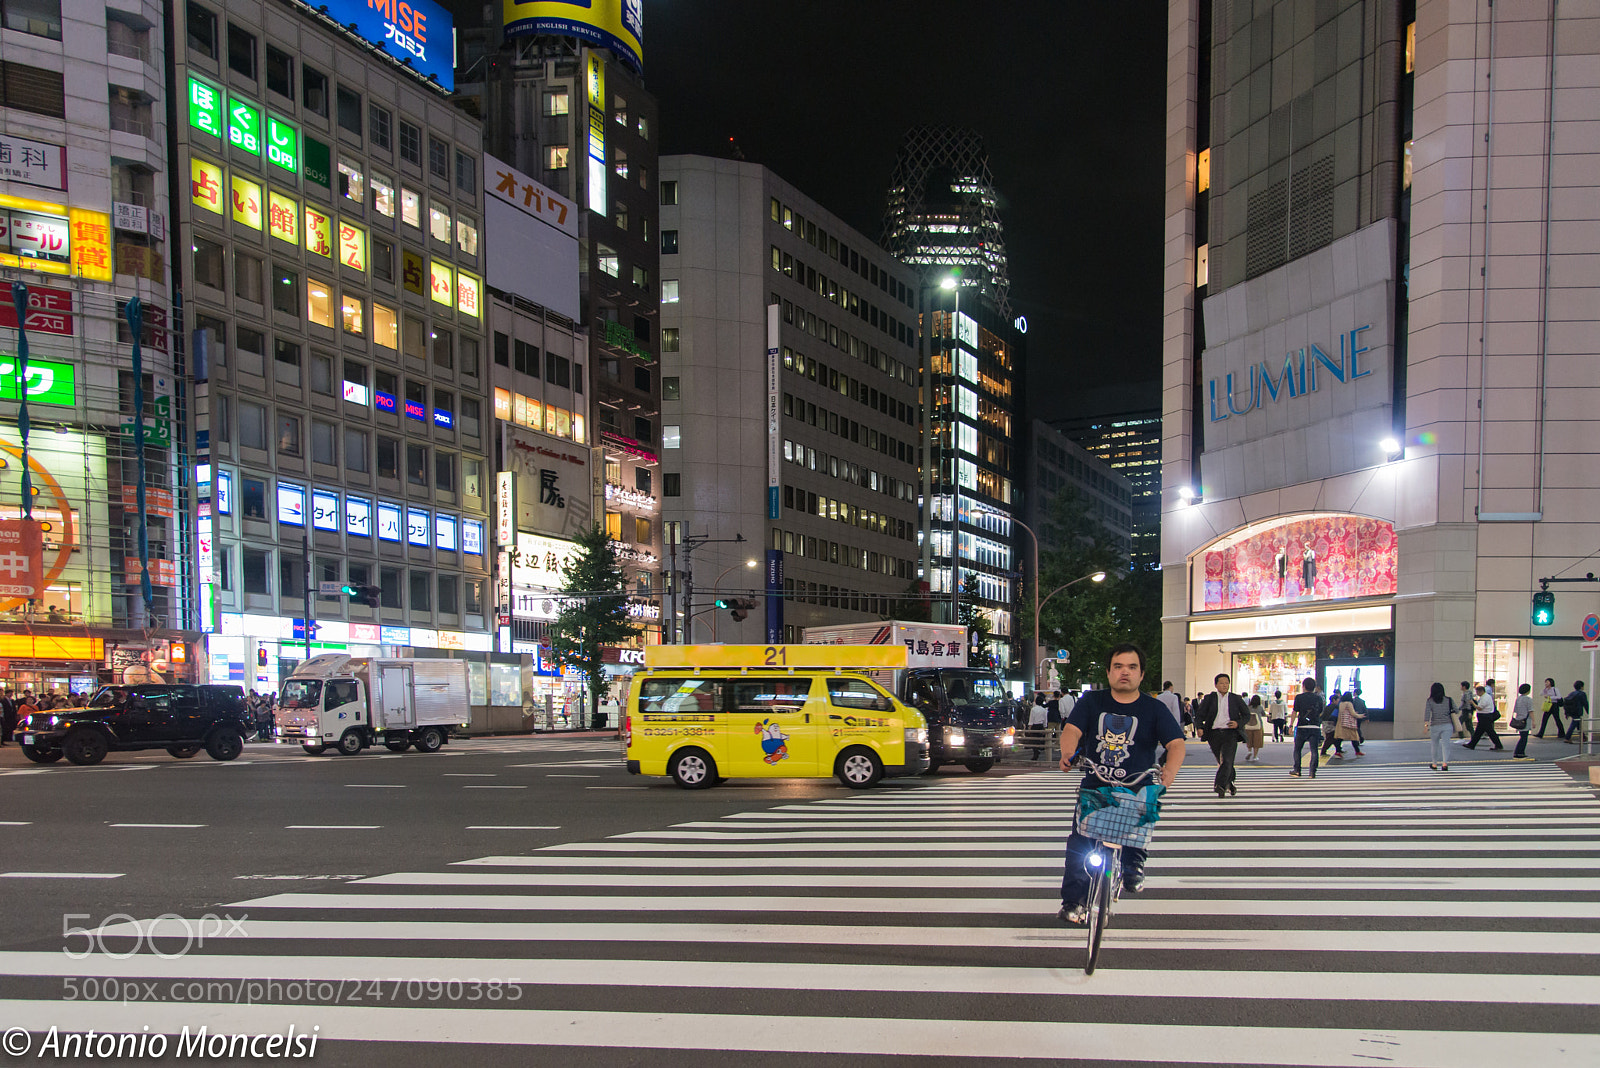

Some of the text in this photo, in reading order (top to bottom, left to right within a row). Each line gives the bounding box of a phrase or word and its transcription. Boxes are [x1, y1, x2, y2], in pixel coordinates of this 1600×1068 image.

[384, 22, 427, 62] プロミス
[536, 22, 568, 31] ENGLISH
[571, 25, 602, 40] SERVICE
[192, 169, 294, 236] 占い館
[496, 170, 568, 225] オガワ
[73, 221, 108, 269] 賃貸
[28, 292, 59, 307] 6F
[403, 258, 475, 310] 占い館
[1209, 324, 1373, 423] LUMINE
[376, 394, 424, 417] PRO MISE
[764, 646, 786, 666] 21
[904, 638, 961, 659] 月島倉庫
[833, 728, 843, 736] 21
